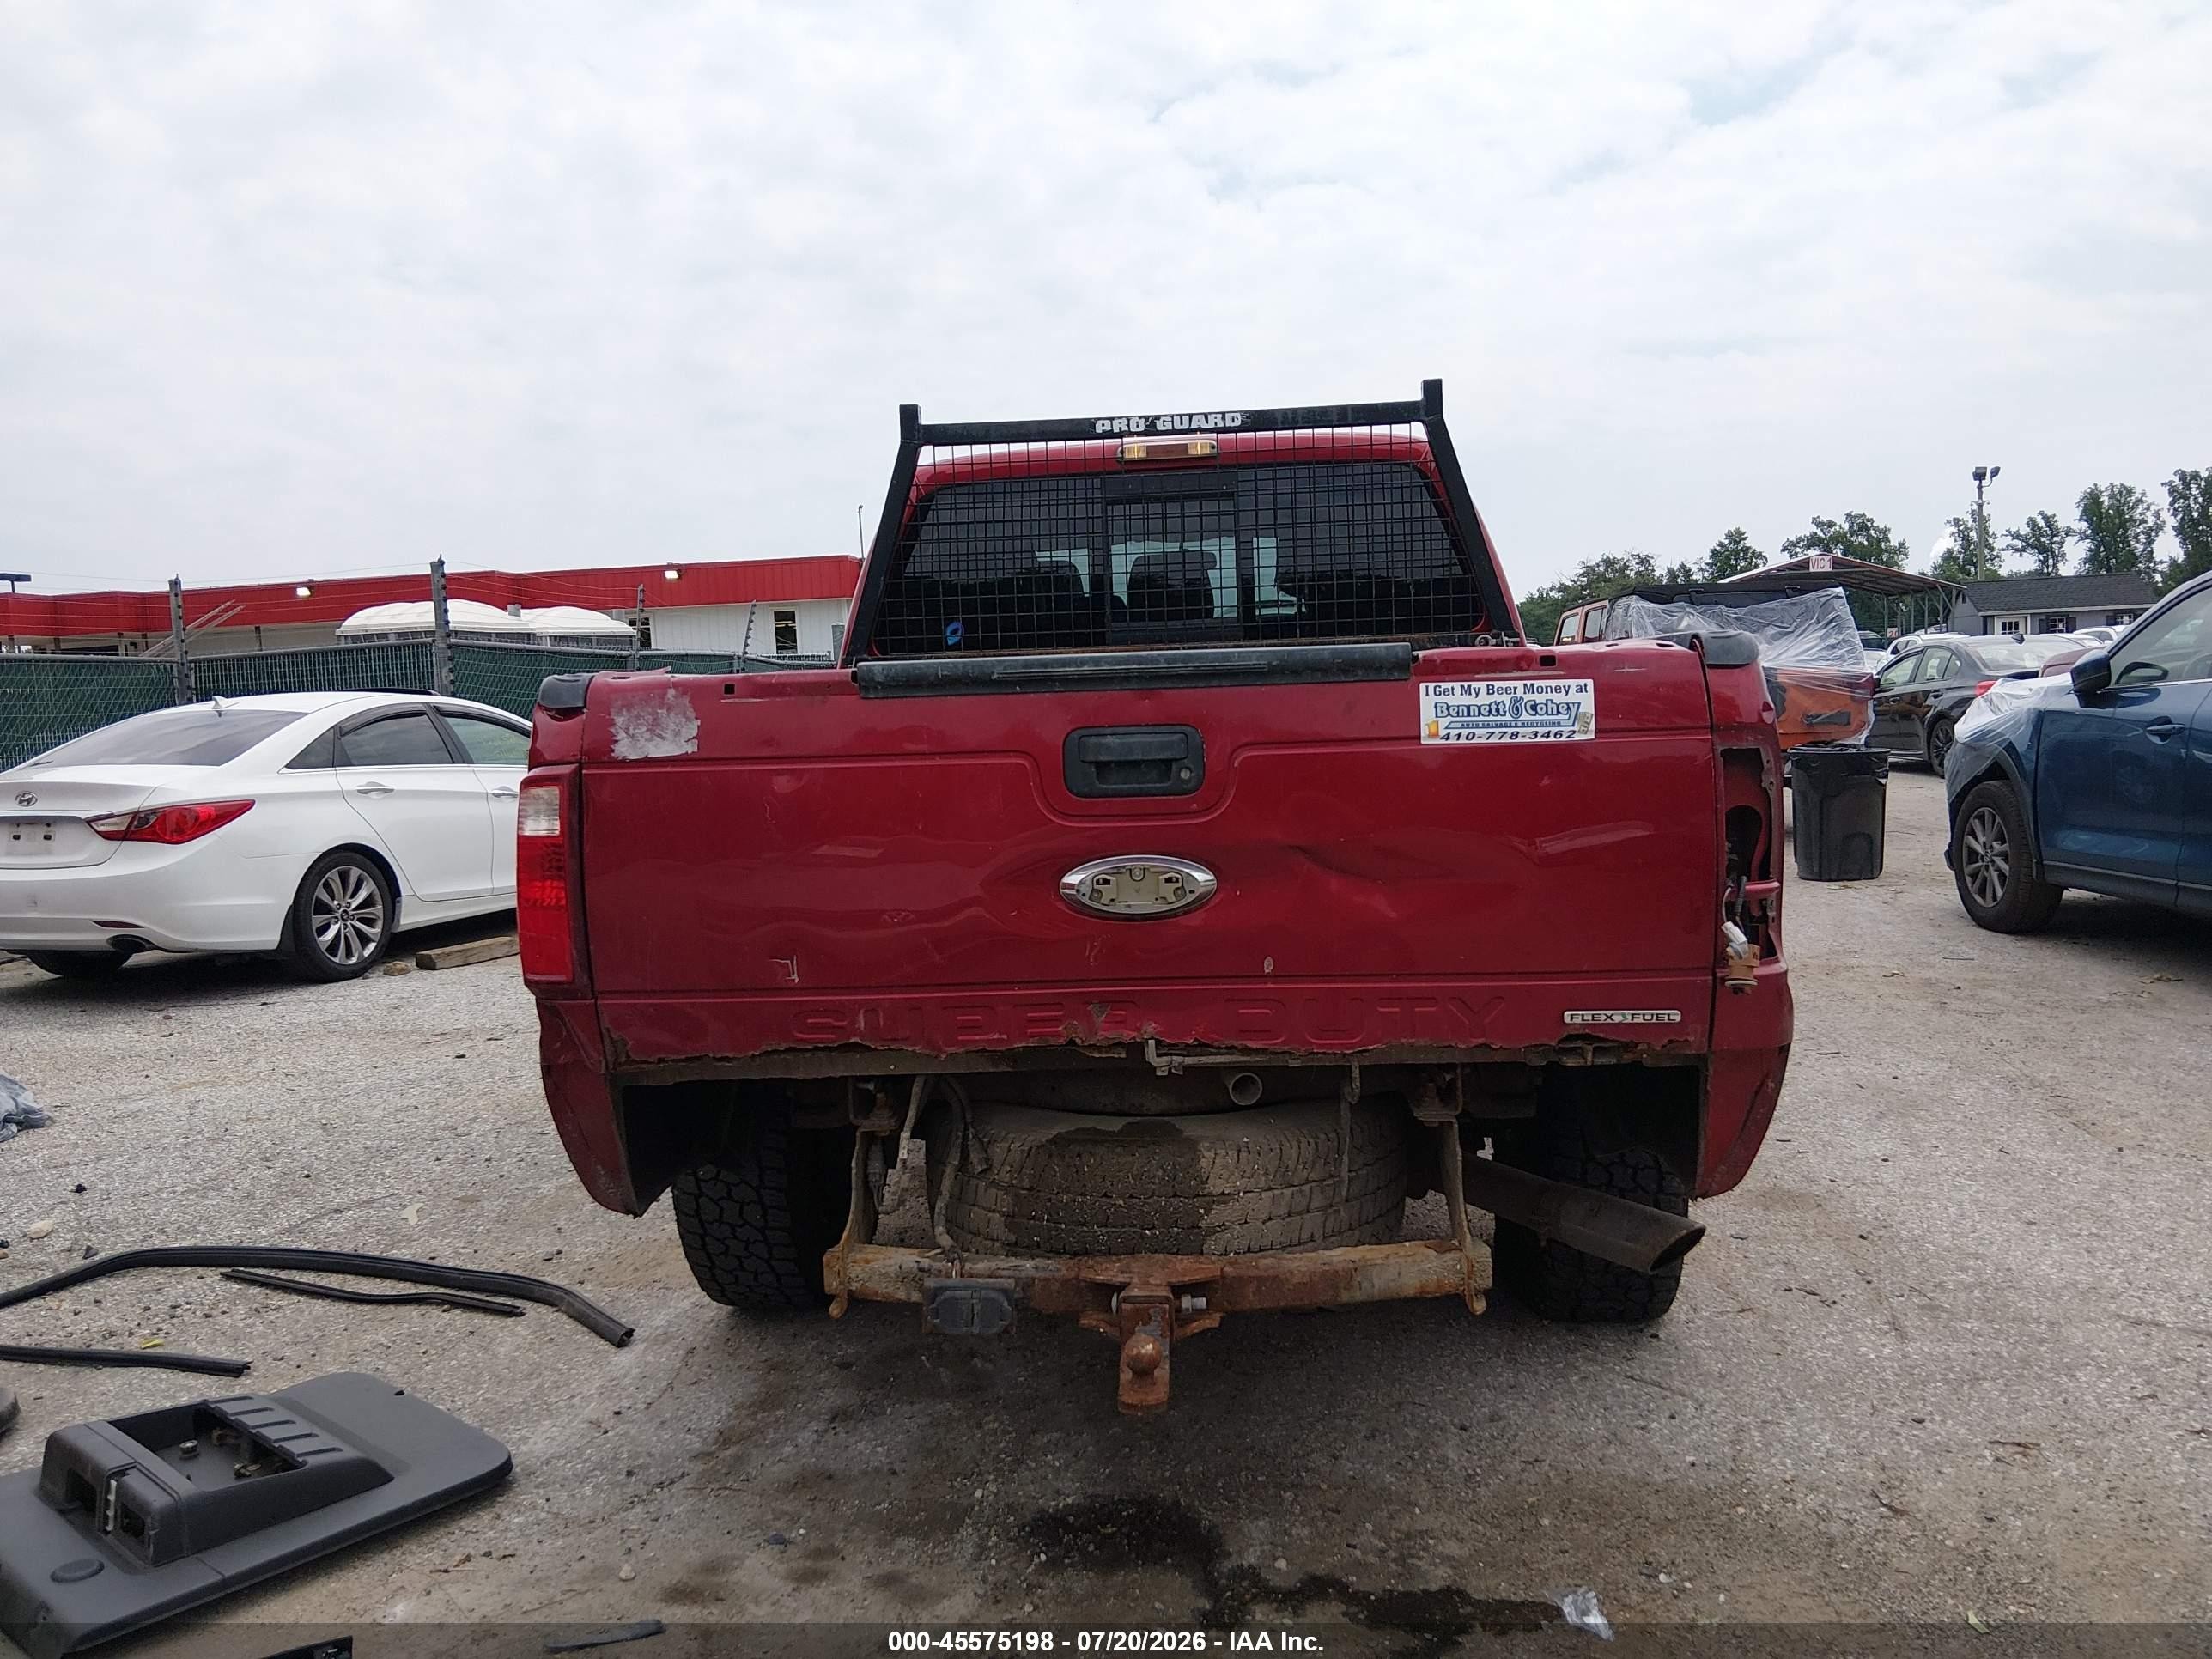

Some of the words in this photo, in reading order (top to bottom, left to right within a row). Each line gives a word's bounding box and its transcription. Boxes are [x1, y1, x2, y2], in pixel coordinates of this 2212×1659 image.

[1095, 416, 1145, 433] PRO
[1156, 412, 1242, 431] GUARD
[1810, 557, 1826, 570] VIC
[1826, 557, 1832, 569] 1
[1425, 684, 1430, 696] I
[1433, 684, 1455, 696] Get
[1460, 684, 1481, 698] My
[1486, 684, 1518, 696] Beer
[1522, 682, 1571, 696] Money
[1575, 682, 1589, 694] at
[1434, 700, 1507, 718] Bennett
[1509, 696, 1524, 719] &
[1524, 698, 1581, 720] Cohey
[1439, 729, 1577, 742] 410-778-3462
[1222, 994, 1509, 1045] DUTY
[1570, 1012, 1615, 1022] FLEX
[1630, 1012, 1677, 1022] FUEL
